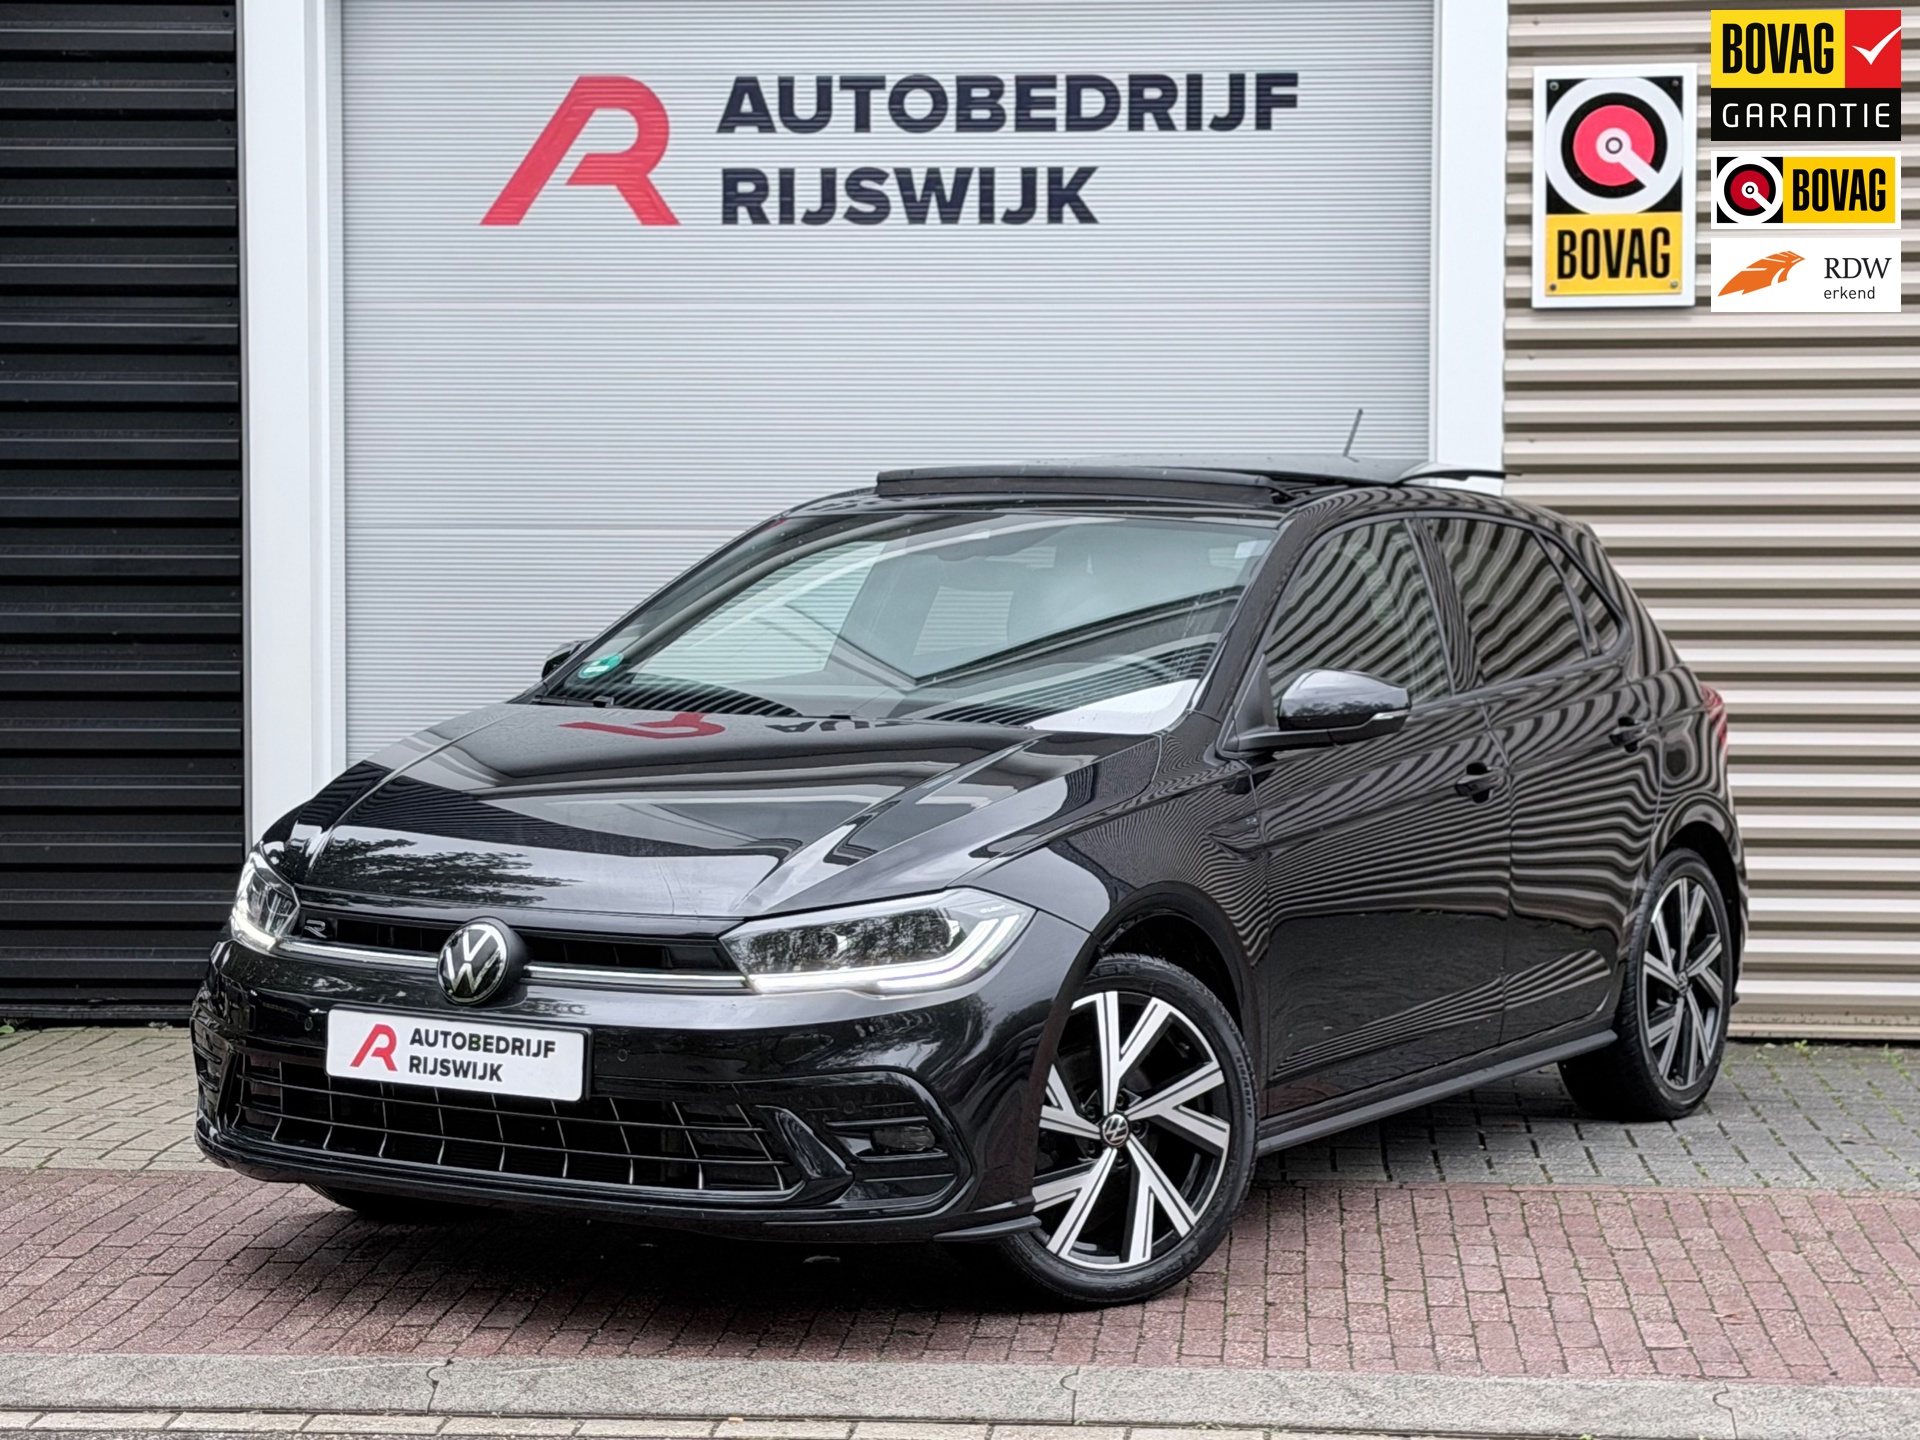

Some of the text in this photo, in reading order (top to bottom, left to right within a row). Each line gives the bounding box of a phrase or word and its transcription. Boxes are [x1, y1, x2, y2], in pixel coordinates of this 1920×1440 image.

[716, 72, 1299, 134] AUTOBEDRIJF
[721, 166, 1099, 226] RIJSWIJK
[1557, 226, 1671, 281] BOVAG
[408, 1054, 504, 1083] RIJSWIJK
[409, 1027, 556, 1059] AUTOBEDRIJF
